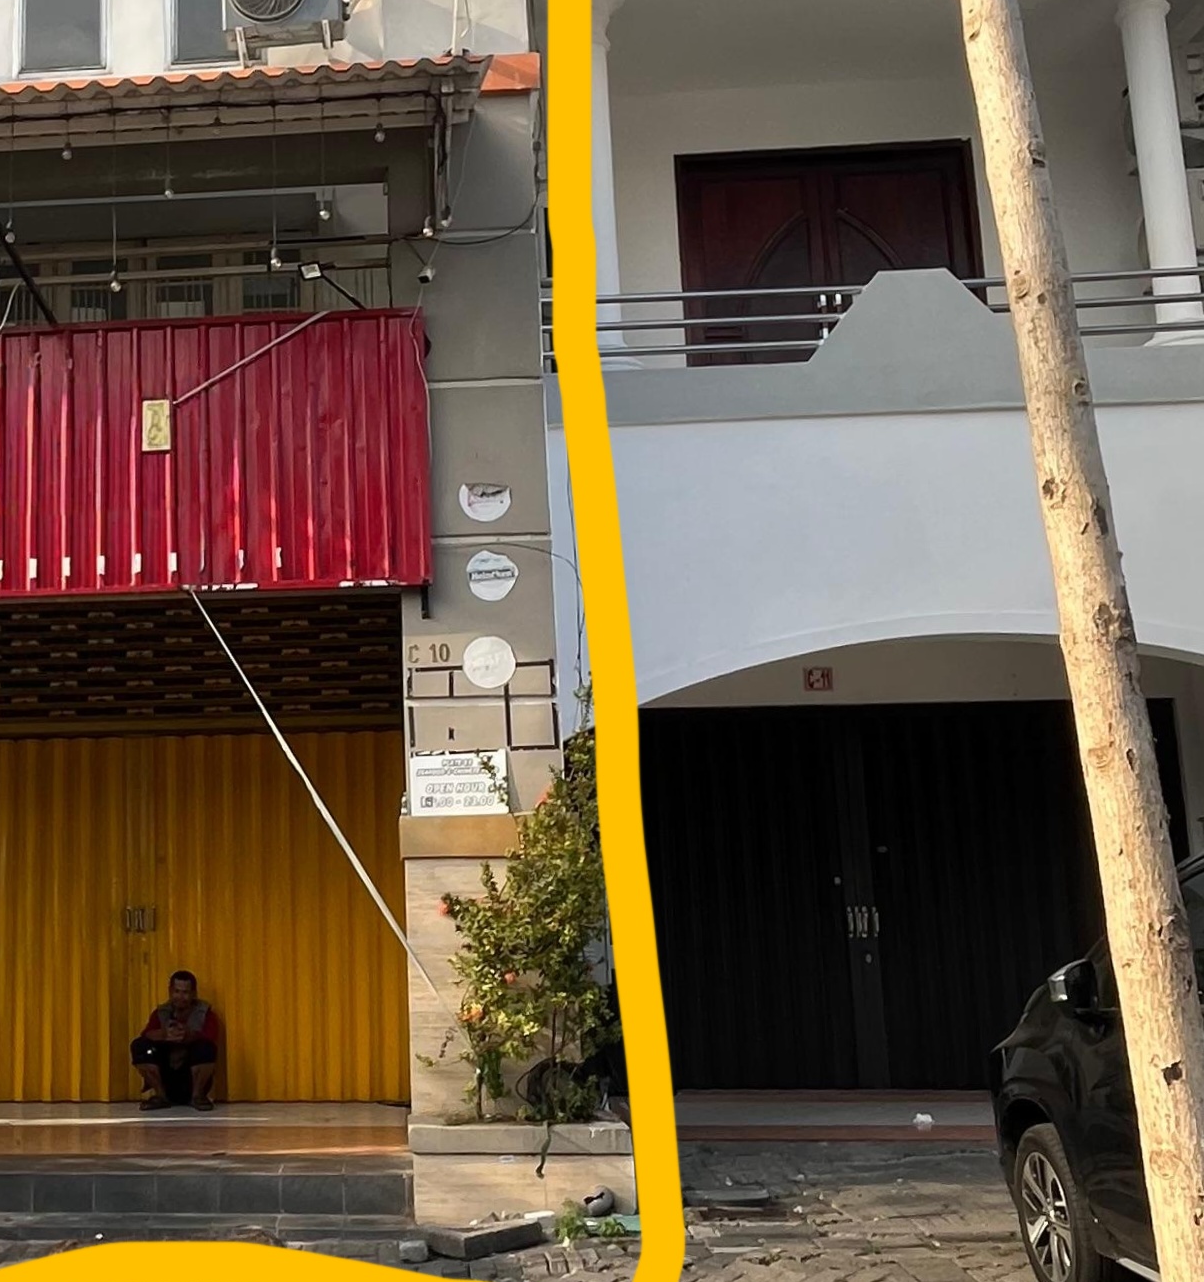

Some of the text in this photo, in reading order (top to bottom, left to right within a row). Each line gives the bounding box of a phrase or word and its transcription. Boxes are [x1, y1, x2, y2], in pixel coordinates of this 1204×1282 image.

[428, 642, 452, 663] 10
[425, 781, 486, 794] OPEN HOUR
